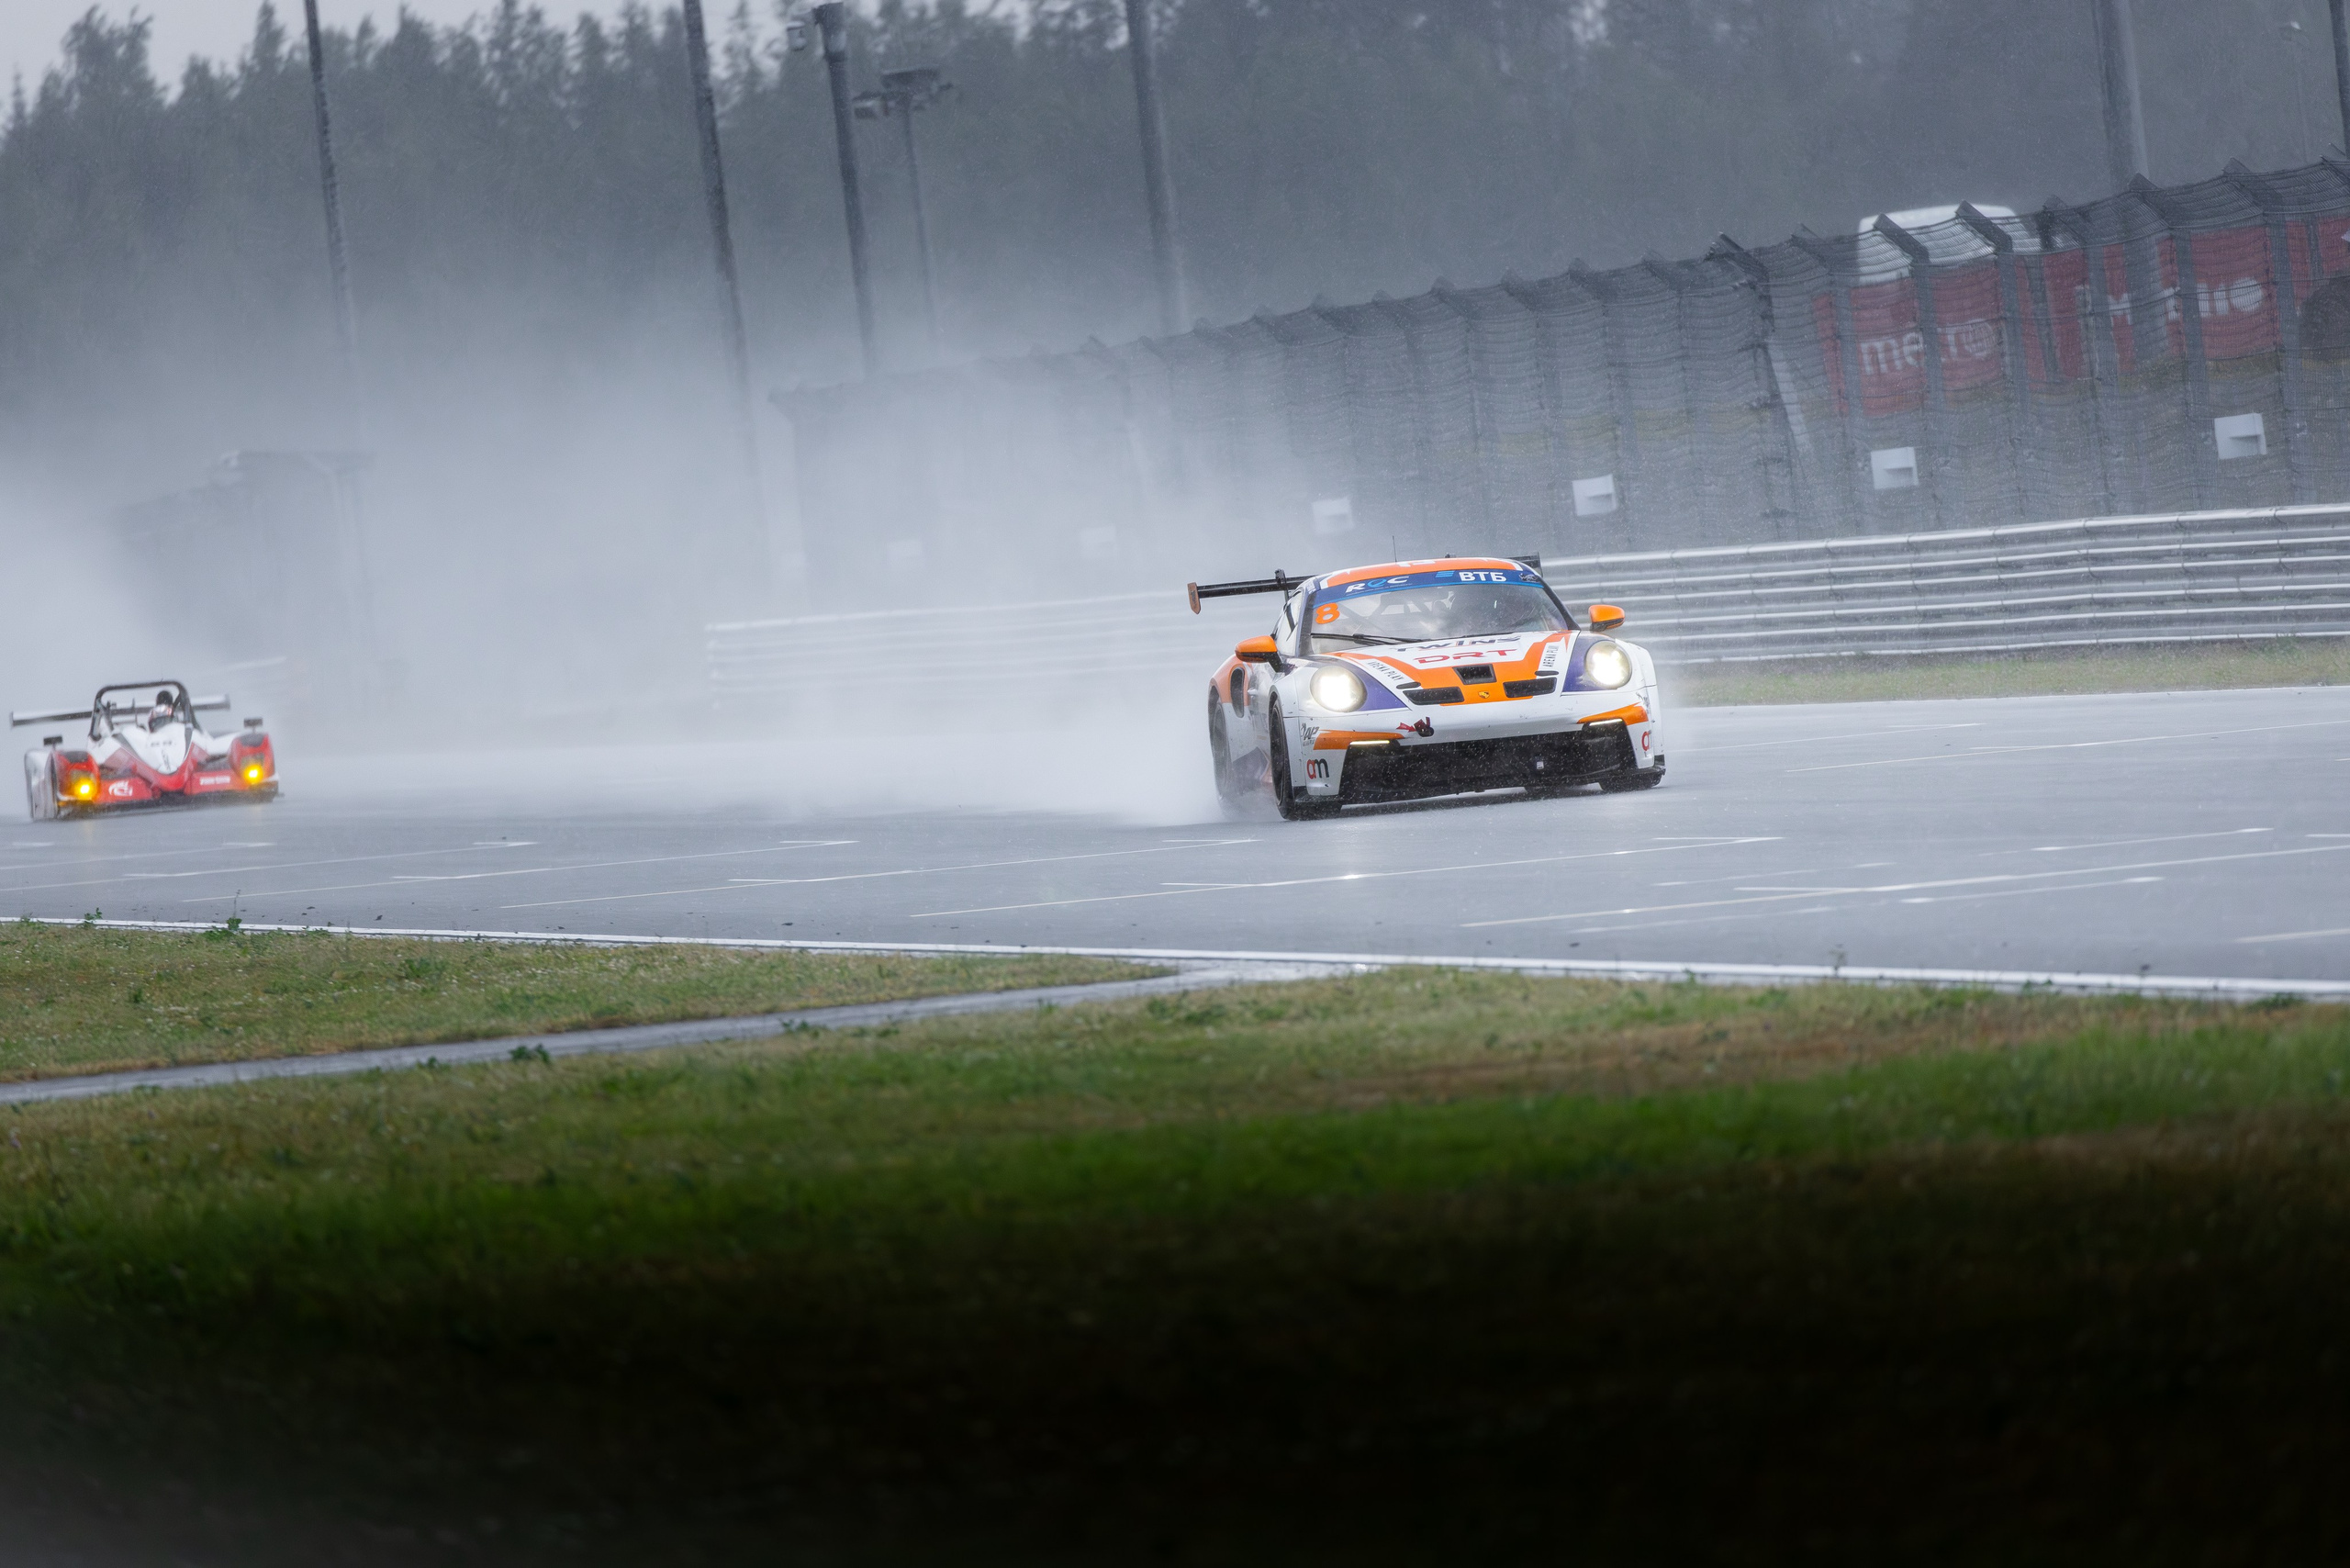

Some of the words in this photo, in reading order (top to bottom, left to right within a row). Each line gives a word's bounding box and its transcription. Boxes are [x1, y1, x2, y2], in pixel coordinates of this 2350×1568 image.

[1861, 319, 1998, 375] mero
[1459, 571, 1507, 582] ВТБ
[1315, 602, 1340, 625] 8
[1413, 649, 1517, 664] DRT
[1306, 758, 1330, 779] am
